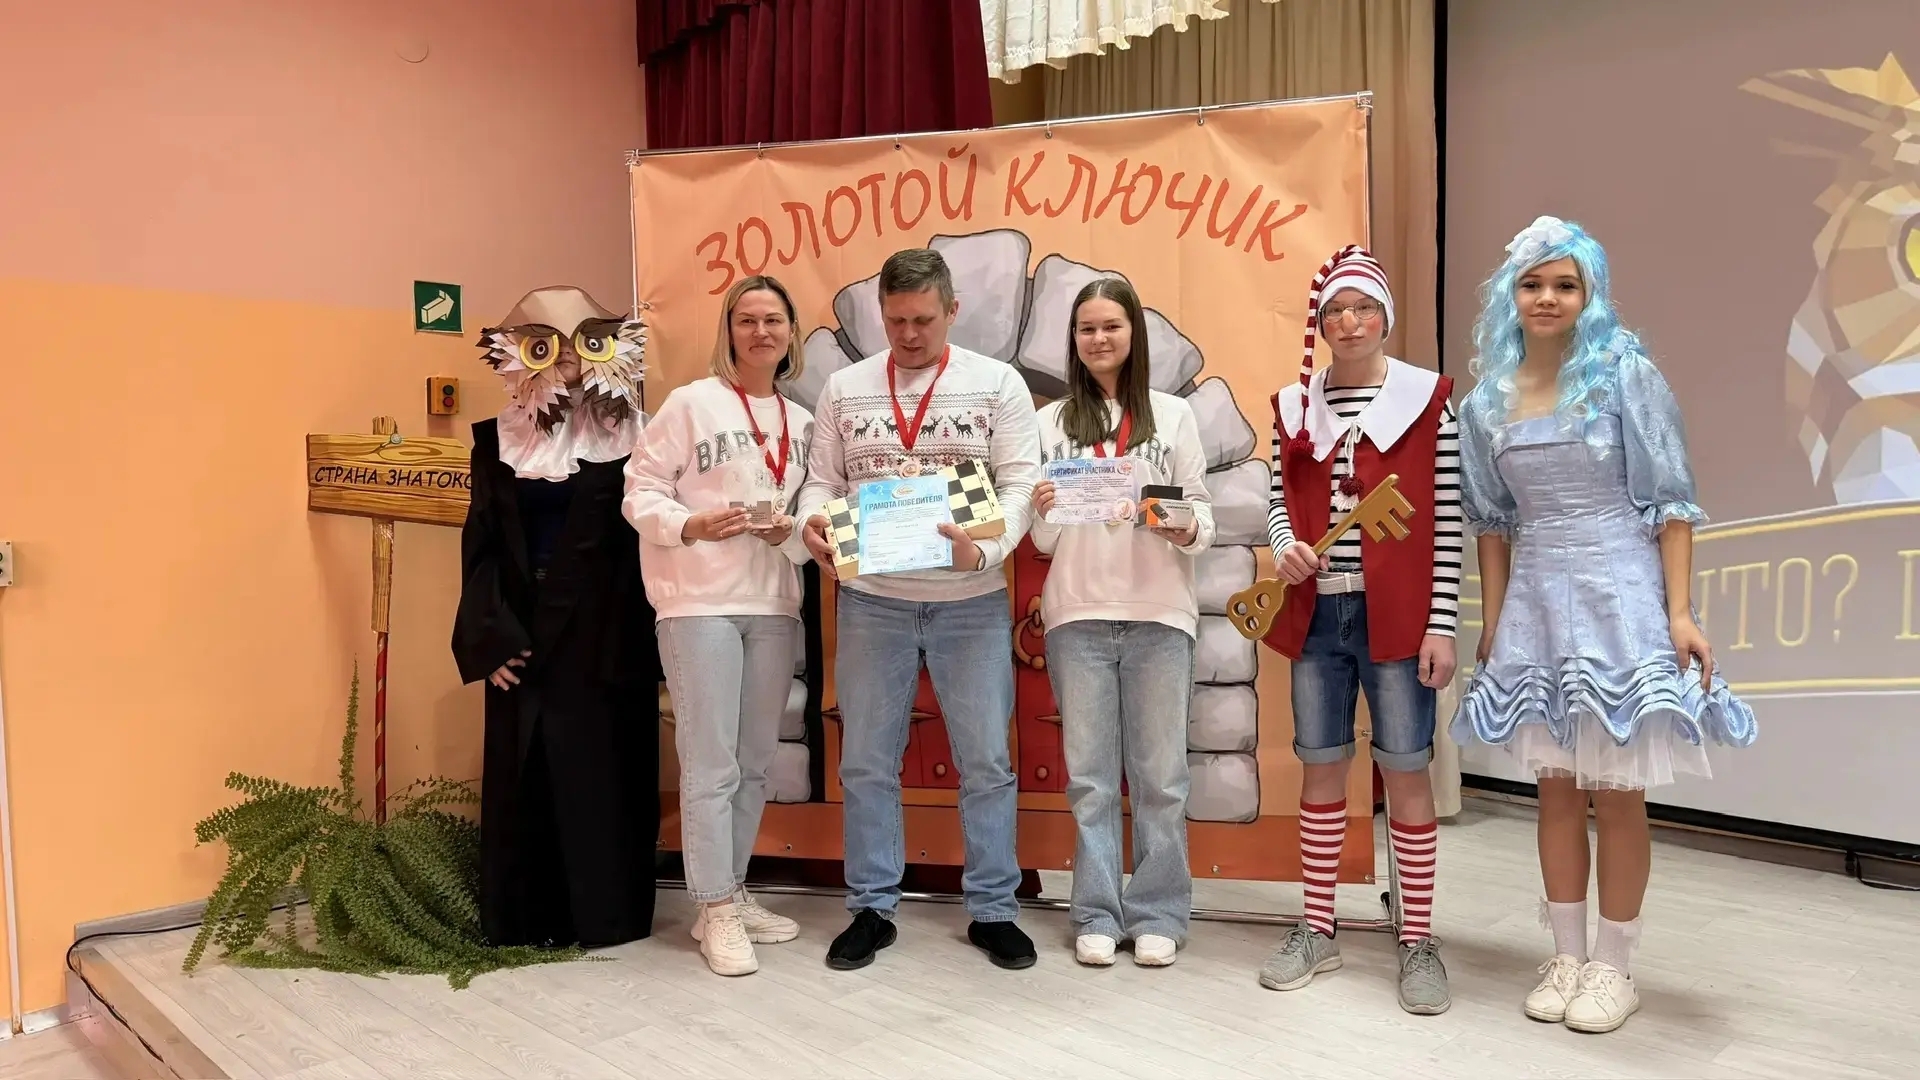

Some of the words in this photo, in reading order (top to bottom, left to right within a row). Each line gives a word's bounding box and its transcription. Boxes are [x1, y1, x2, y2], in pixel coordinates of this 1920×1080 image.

[696, 142, 978, 296] ЗОЛОТОЙ
[1003, 150, 1308, 262] КЛЮЧИК
[314, 466, 378, 485] СТРАНА
[1050, 467, 1084, 477] СЕРТИФИКАТ
[865, 501, 897, 511] ГРАМОТА
[897, 494, 943, 508] ПОБЕДИТЕЛЯ
